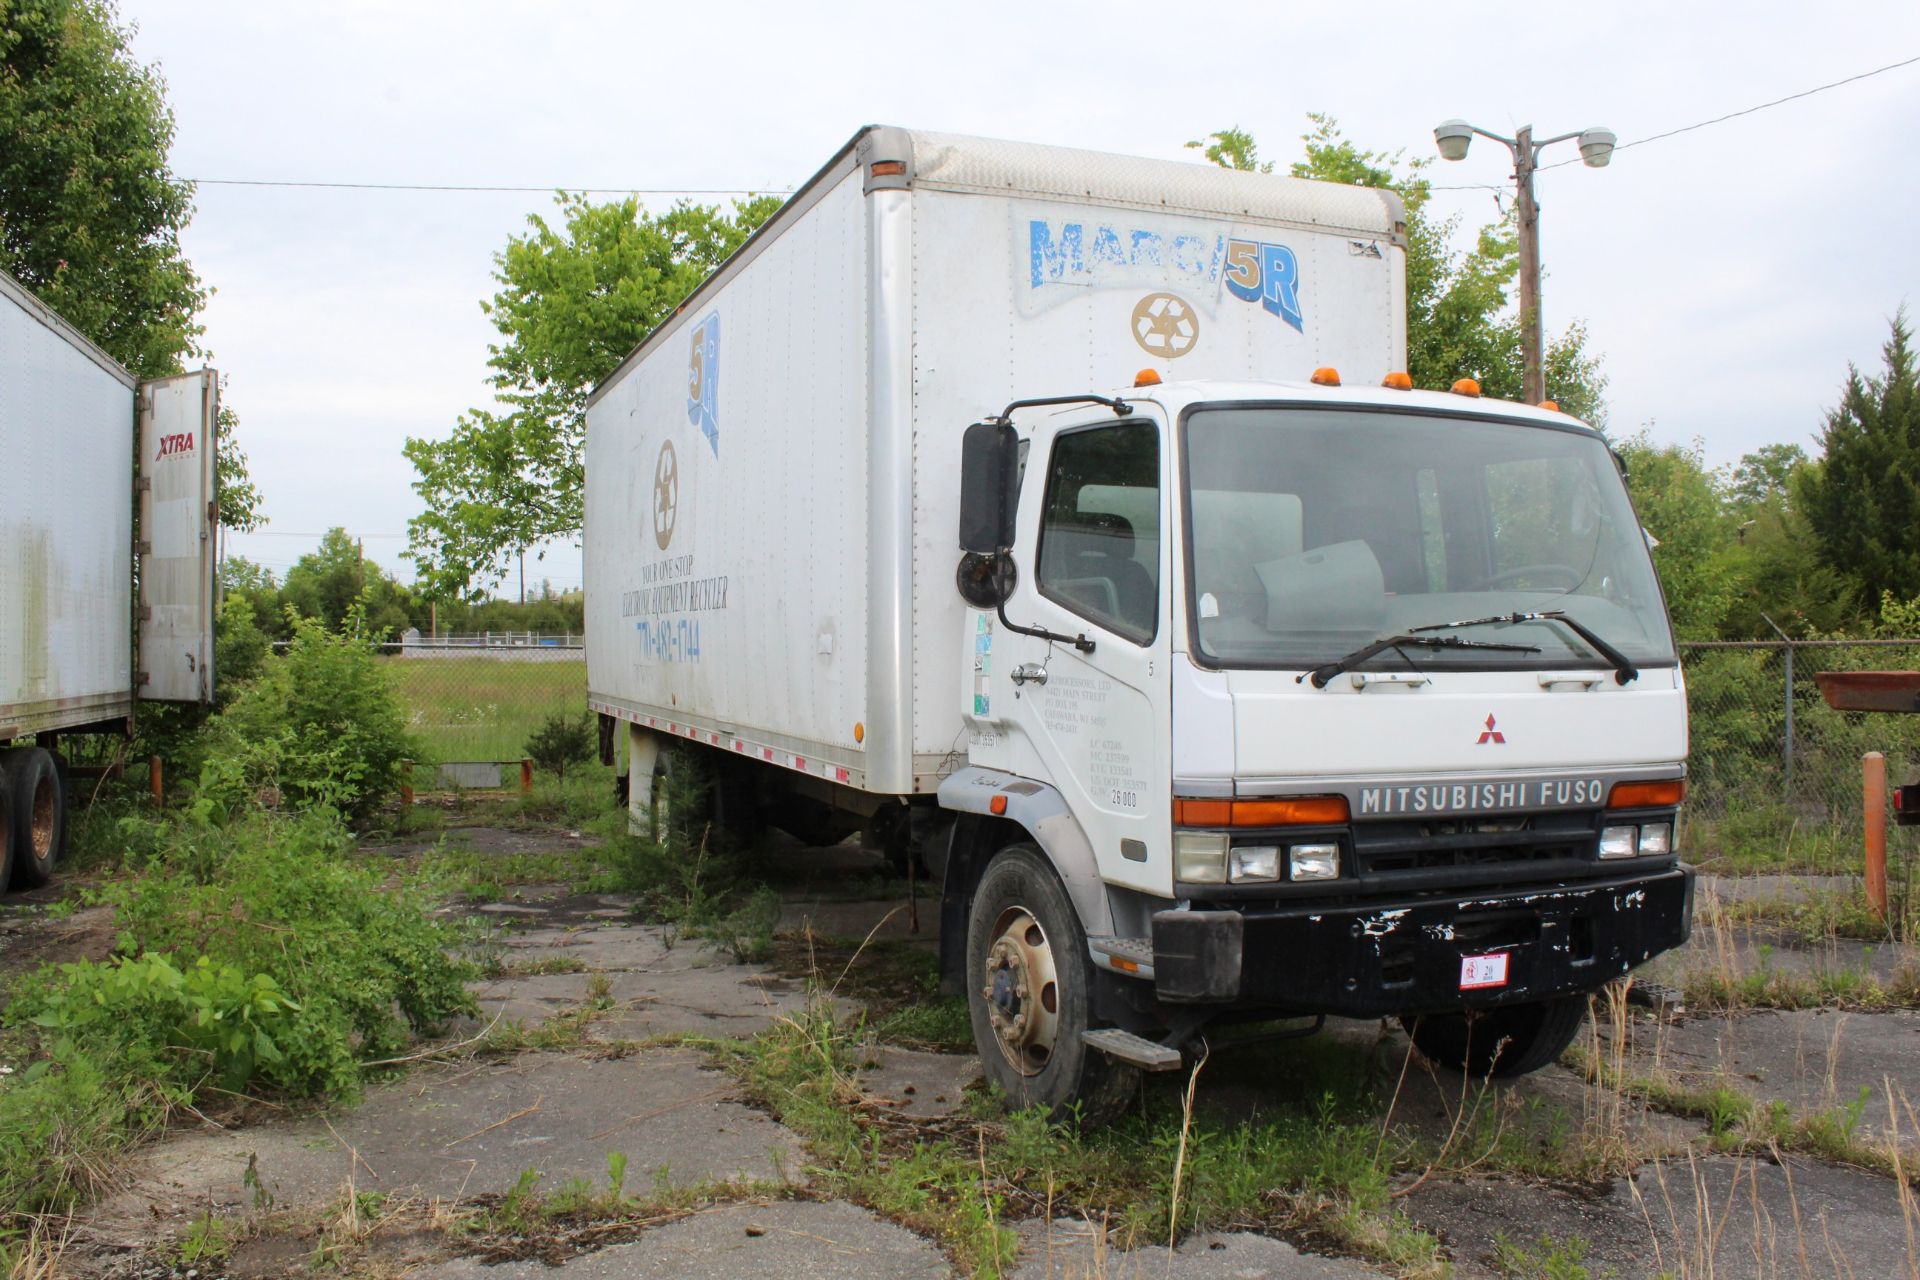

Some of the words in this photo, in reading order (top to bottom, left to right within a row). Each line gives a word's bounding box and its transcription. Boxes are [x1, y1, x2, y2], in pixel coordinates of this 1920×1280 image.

[155, 432, 194, 462] XTRA
[642, 562, 658, 584] YOUR
[660, 558, 673, 580] ONE
[675, 554, 694, 578] STOP
[622, 588, 652, 618] ELECTRONIC
[652, 580, 689, 619] EQUIPMENT
[689, 575, 729, 612] RECYCLER
[636, 619, 700, 664] 770-482-1744
[1148, 661, 1155, 677] 5
[1061, 688, 1080, 699] MAIN
[1082, 691, 1107, 702] STREET
[1112, 788, 1121, 805] 26
[1123, 790, 1137, 808] 000
[1362, 782, 1527, 813] MITSUBISHI
[1540, 779, 1603, 806] FUSO
